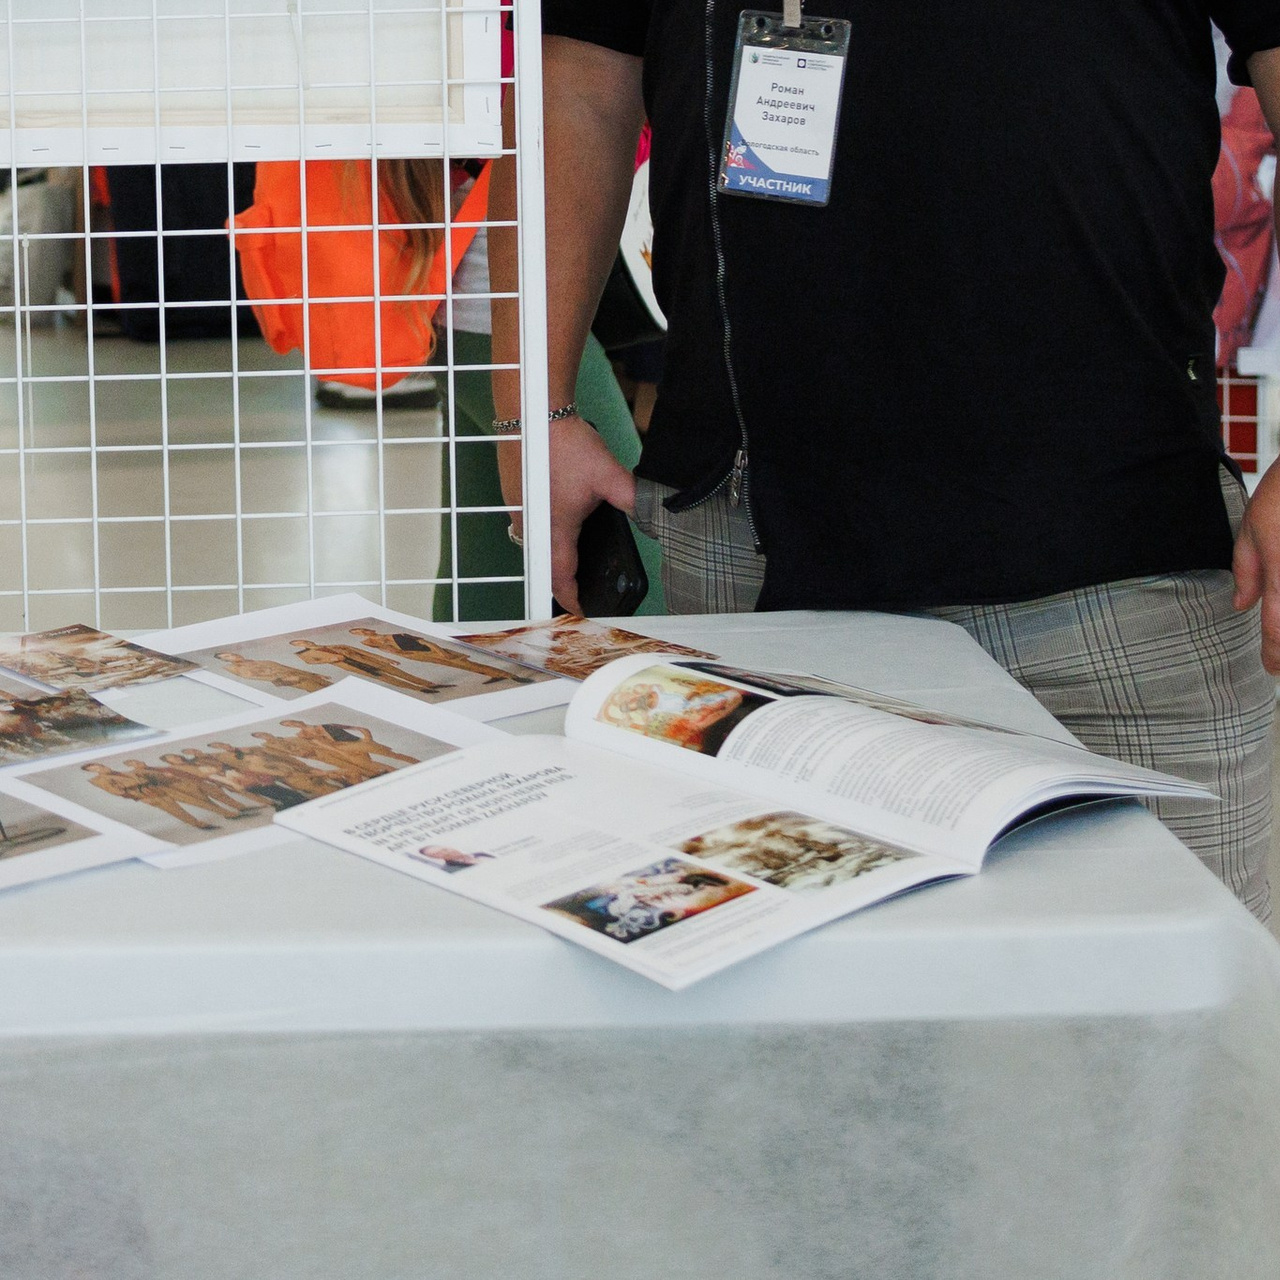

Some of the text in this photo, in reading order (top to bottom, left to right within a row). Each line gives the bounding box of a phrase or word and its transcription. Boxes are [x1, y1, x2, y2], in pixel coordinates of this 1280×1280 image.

[771, 82, 804, 95] Роман
[756, 96, 815, 111] Андреевич
[762, 111, 806, 125] Захаров
[790, 146, 819, 156] область
[739, 175, 812, 195] УЧАСТНИК
